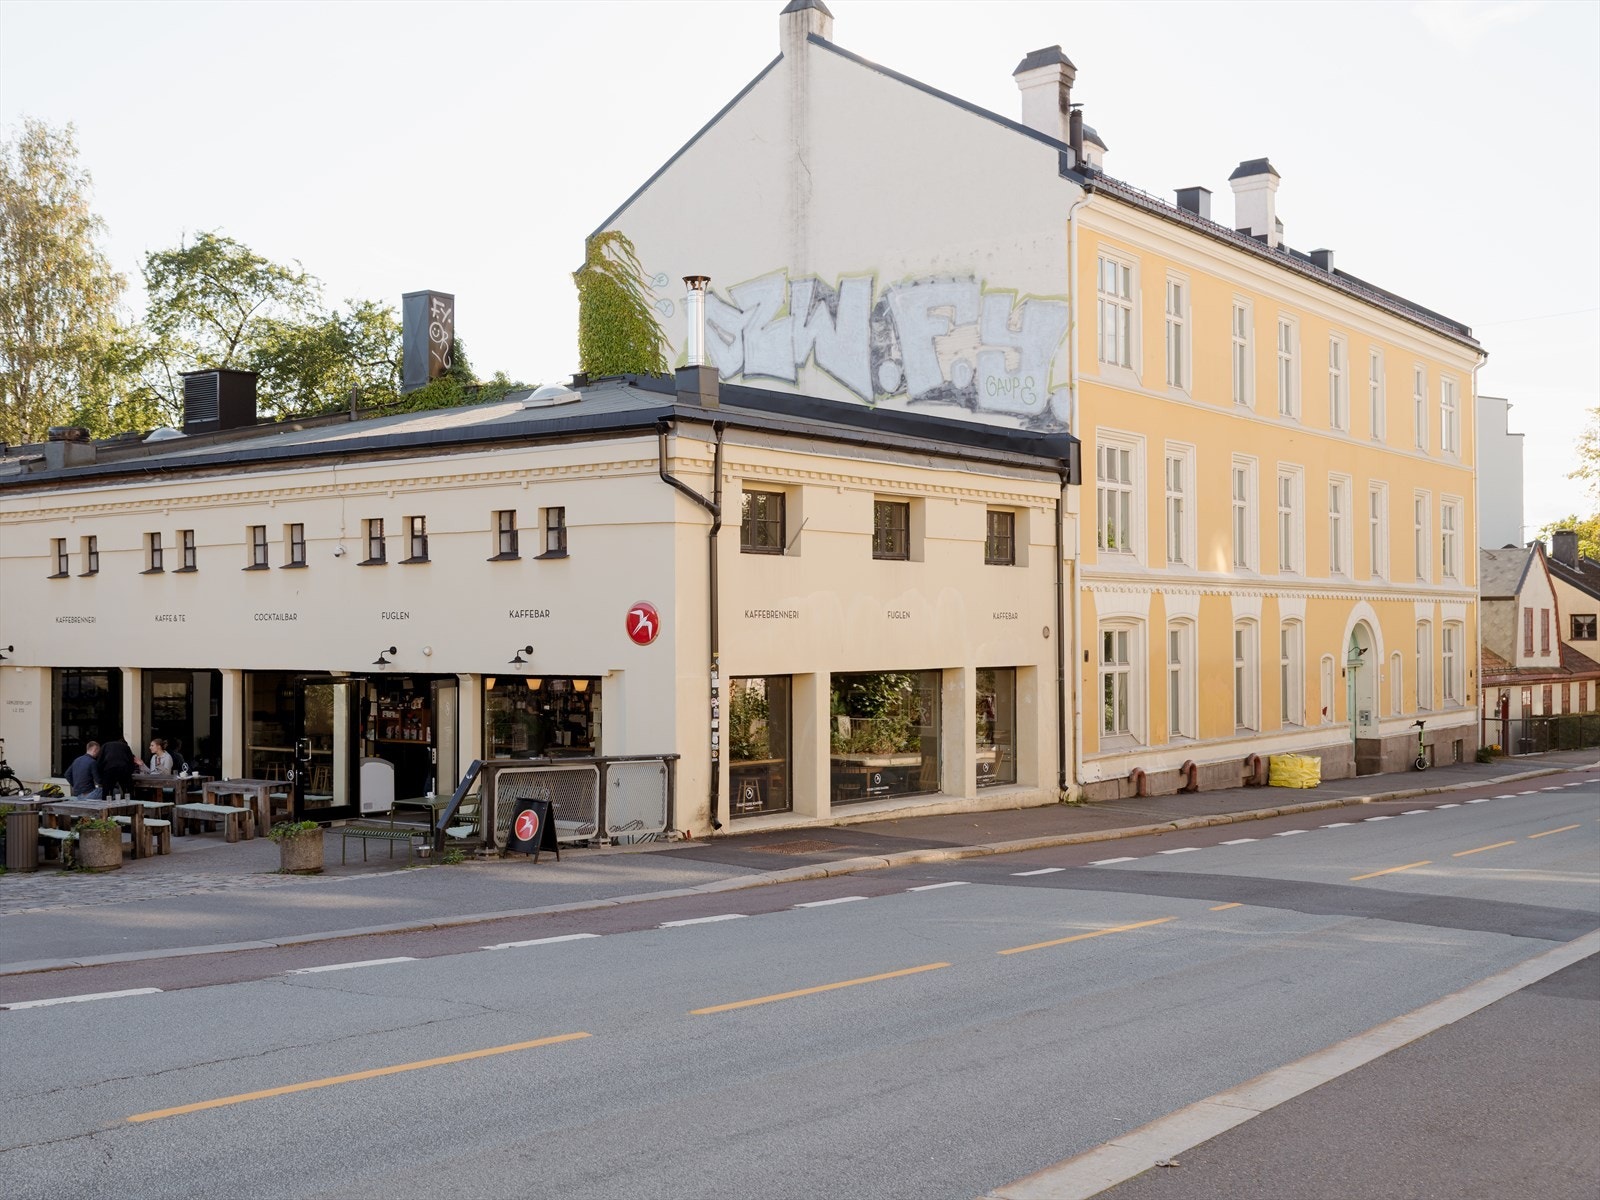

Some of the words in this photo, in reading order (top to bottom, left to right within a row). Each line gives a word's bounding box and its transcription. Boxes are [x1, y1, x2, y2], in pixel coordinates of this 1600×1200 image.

[154, 614, 173, 622] KAFFE
[178, 614, 186, 622] TE
[253, 613, 298, 621] COCKTAILBAR
[381, 611, 410, 620] FUGLEN
[509, 609, 551, 619] KAFFEBAR
[744, 610, 800, 619] KAFFEBRENNERI
[887, 611, 911, 619] FUGLEN
[992, 611, 1019, 620] KAFFEBAR
[55, 616, 97, 624] KAFFEBRENNERI
